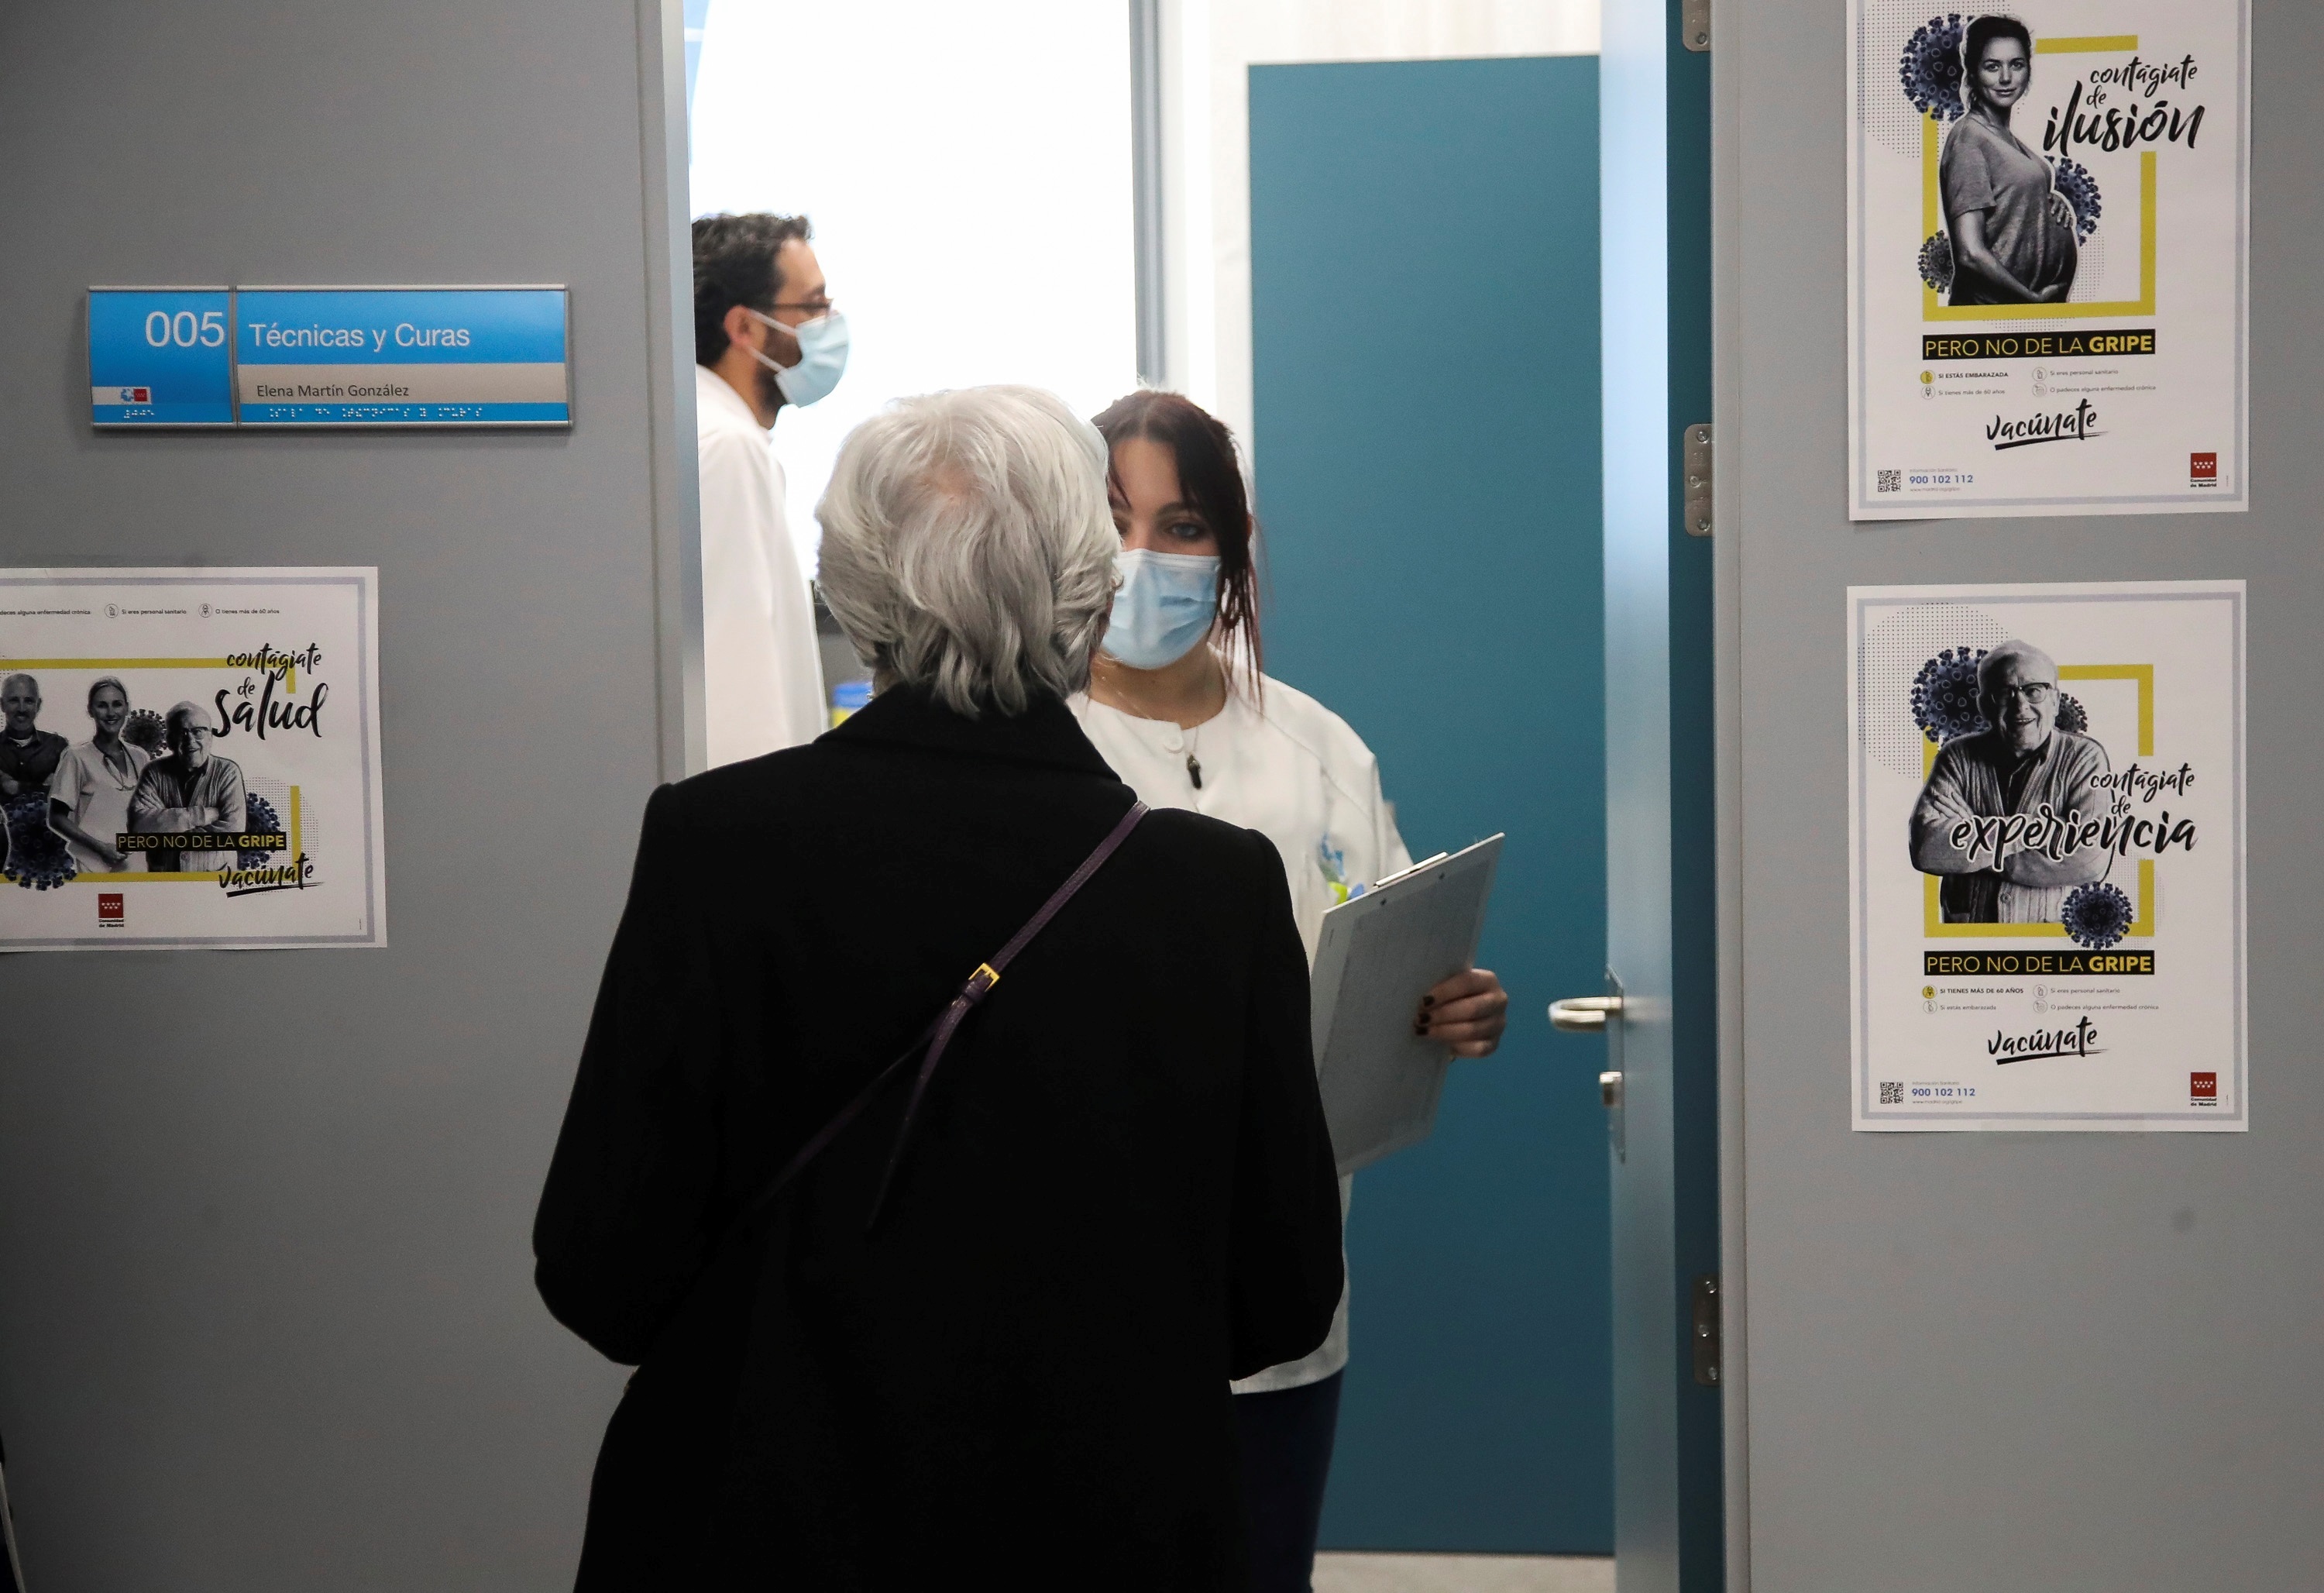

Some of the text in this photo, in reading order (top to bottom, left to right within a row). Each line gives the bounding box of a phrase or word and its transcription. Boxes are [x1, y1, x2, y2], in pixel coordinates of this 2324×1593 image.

[2091, 54, 2198, 98] contágiate
[2086, 84, 2106, 108] de
[2043, 80, 2205, 157] ilusión
[145, 311, 225, 348] 005
[249, 323, 470, 352] Técnicas y Curas
[1926, 335, 2153, 357] PERO NO DE LA GRIPE
[257, 384, 408, 398] Elena Martín González
[1933, 475, 1951, 483] 102
[226, 642, 321, 681] contágiate
[237, 676, 255, 699] de
[2090, 762, 2195, 803] contágiate
[2111, 796, 2130, 817] de
[119, 834, 285, 848] PERO NO DE LA GRIPE
[1951, 803, 2197, 871] experiencia
[1927, 956, 2152, 973] PERO NO DE LA GRIPE
[1958, 1088, 1975, 1096] 112
